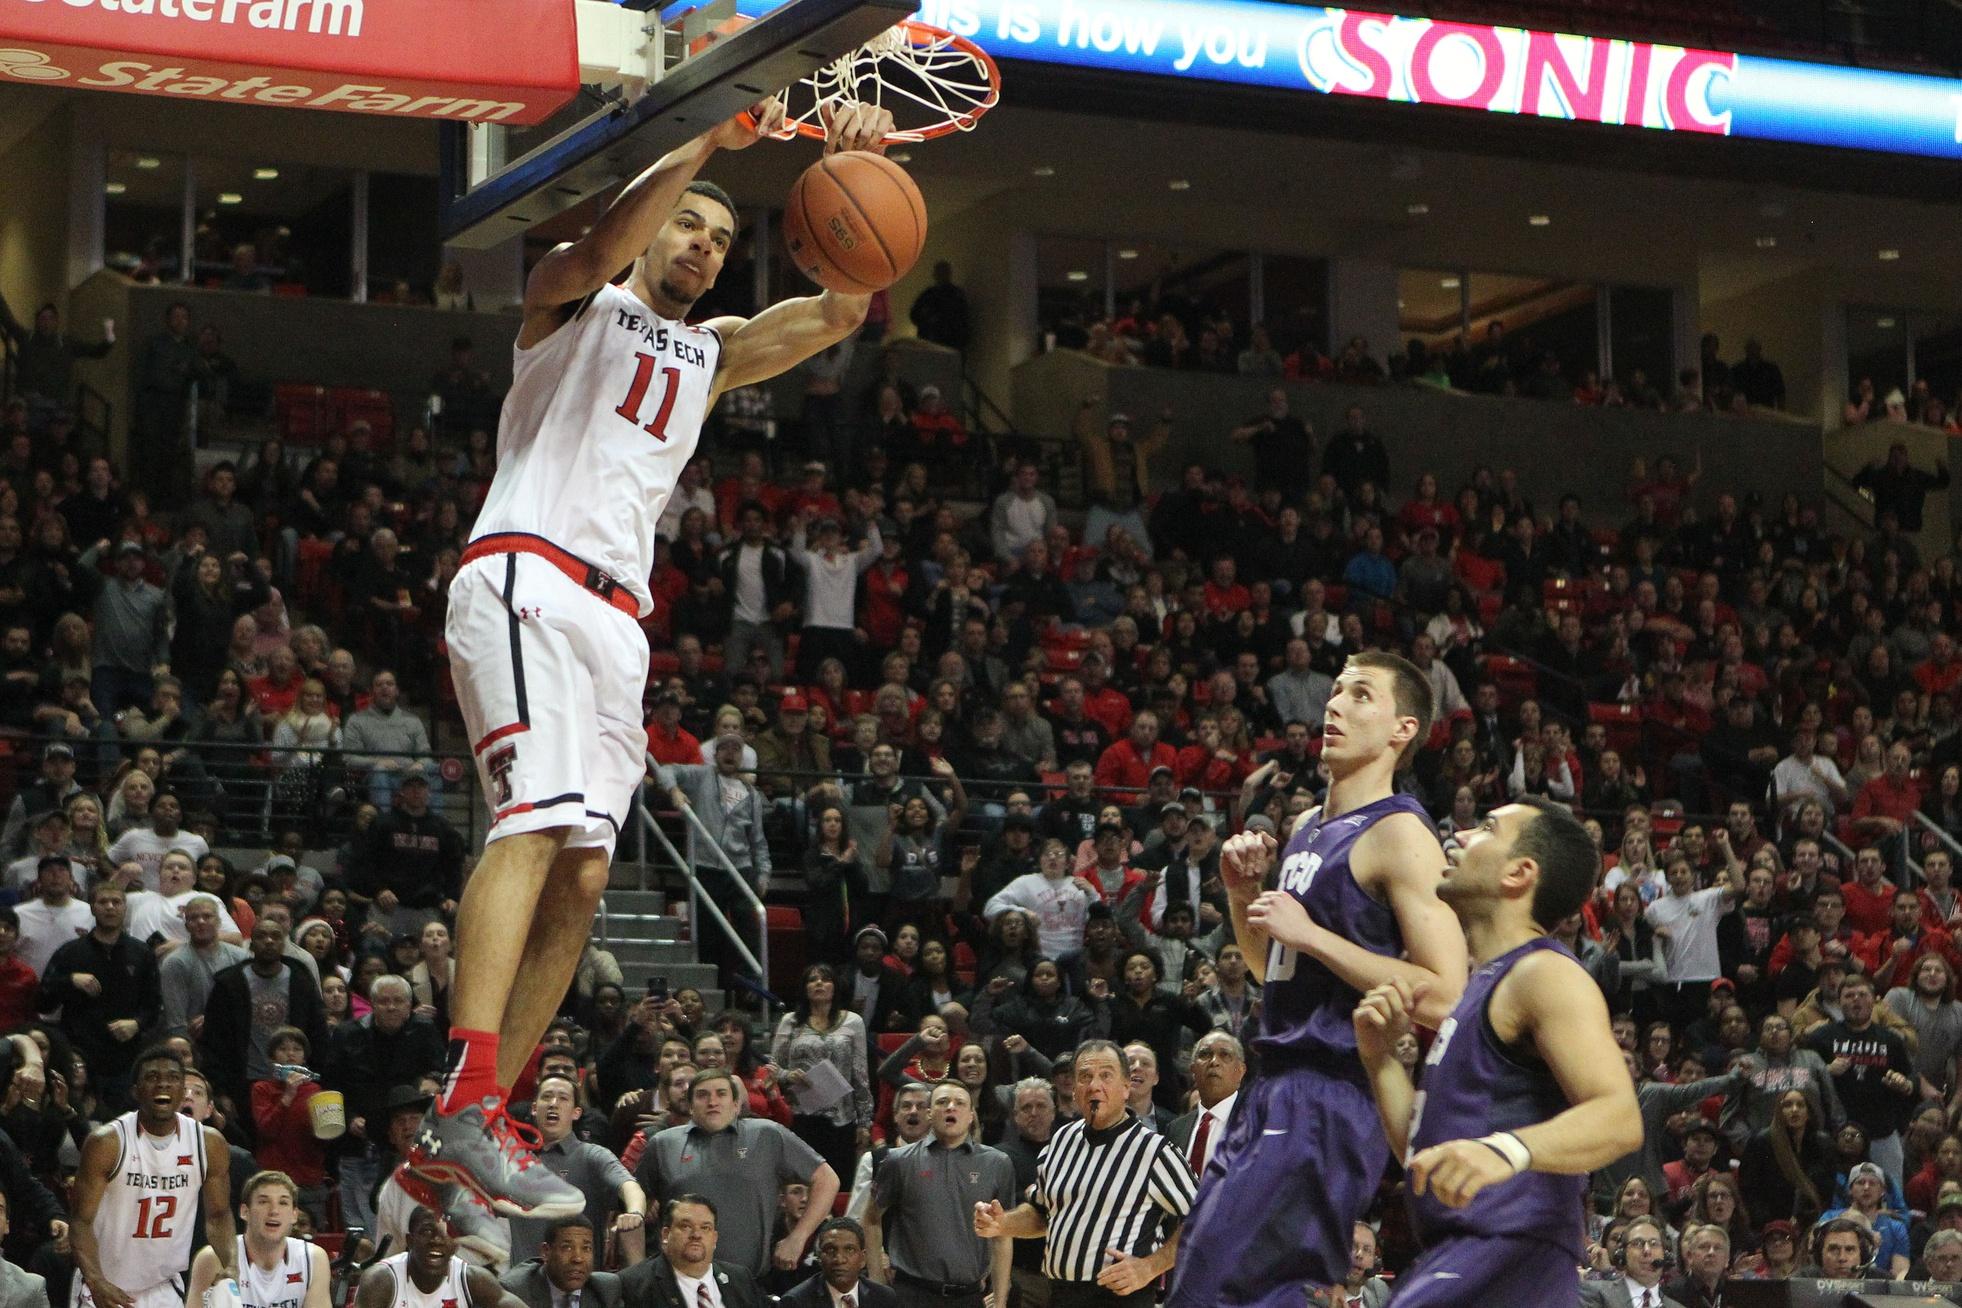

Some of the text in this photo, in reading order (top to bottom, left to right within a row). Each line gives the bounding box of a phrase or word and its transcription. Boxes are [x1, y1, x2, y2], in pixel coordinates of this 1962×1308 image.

[1057, 0, 1164, 55] how
[1174, 24, 1267, 71] you
[77, 61, 526, 120] State Farm
[1300, 8, 1737, 136] SONIC
[615, 351, 681, 443] 11
[126, 1172, 189, 1190] TEXAS TECH
[132, 1196, 178, 1239] 12
